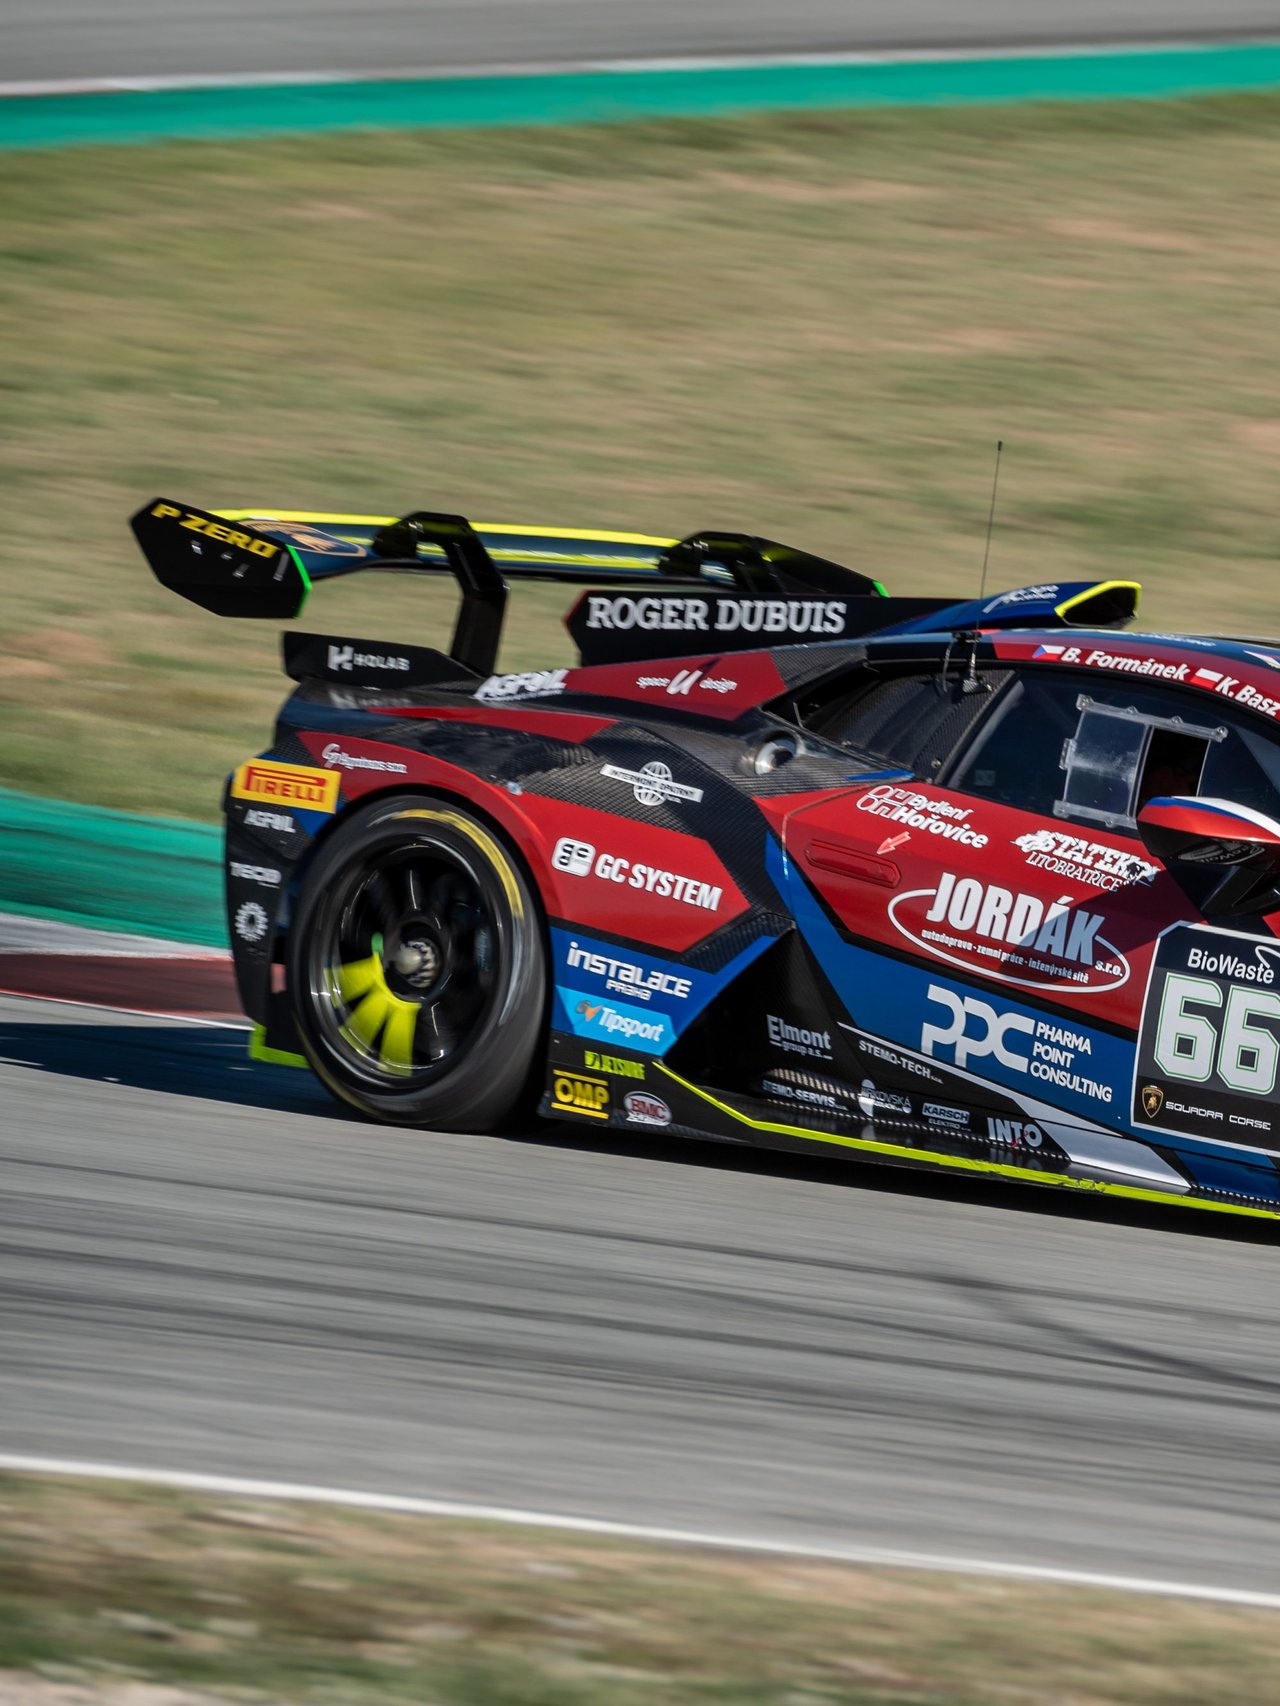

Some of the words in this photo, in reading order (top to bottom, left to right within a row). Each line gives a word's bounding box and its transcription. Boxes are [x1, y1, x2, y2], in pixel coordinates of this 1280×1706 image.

[152, 504, 181, 519] P
[177, 514, 280, 558] ZERO
[586, 597, 709, 630] ROGER
[714, 600, 848, 633] DUBUIS
[1060, 647, 1080, 664] B.
[1085, 650, 1191, 681] Formánek
[1214, 676, 1234, 696] K.
[245, 766, 327, 803] PIRELLI
[891, 806, 989, 848] Hořovice
[595, 854, 630, 883] GC
[628, 863, 722, 911] SYSTEM
[926, 872, 1105, 965] JORDÁK
[921, 930, 973, 950] autodoprava
[1095, 960, 1124, 976] s.r.o.
[1187, 946, 1275, 984] BioWaste
[598, 1007, 665, 1042] Tipsport
[767, 1014, 832, 1050] Elmont
[920, 984, 1035, 1074] PPC
[1035, 1021, 1092, 1055] PHARMA
[859, 1040, 931, 1079] STEMO-TECH
[1033, 1041, 1075, 1069] POINT
[554, 1078, 610, 1110] OMP
[762, 1079, 835, 1108] STEMO-SERVIS
[1030, 1061, 1112, 1103] CONSULTING
[631, 1098, 666, 1119] BMC
[924, 1104, 969, 1122] KARSCH
[1165, 1101, 1224, 1120] SQUADRA
[1229, 1114, 1272, 1131] CORSE
[987, 1116, 1042, 1148] INTO
